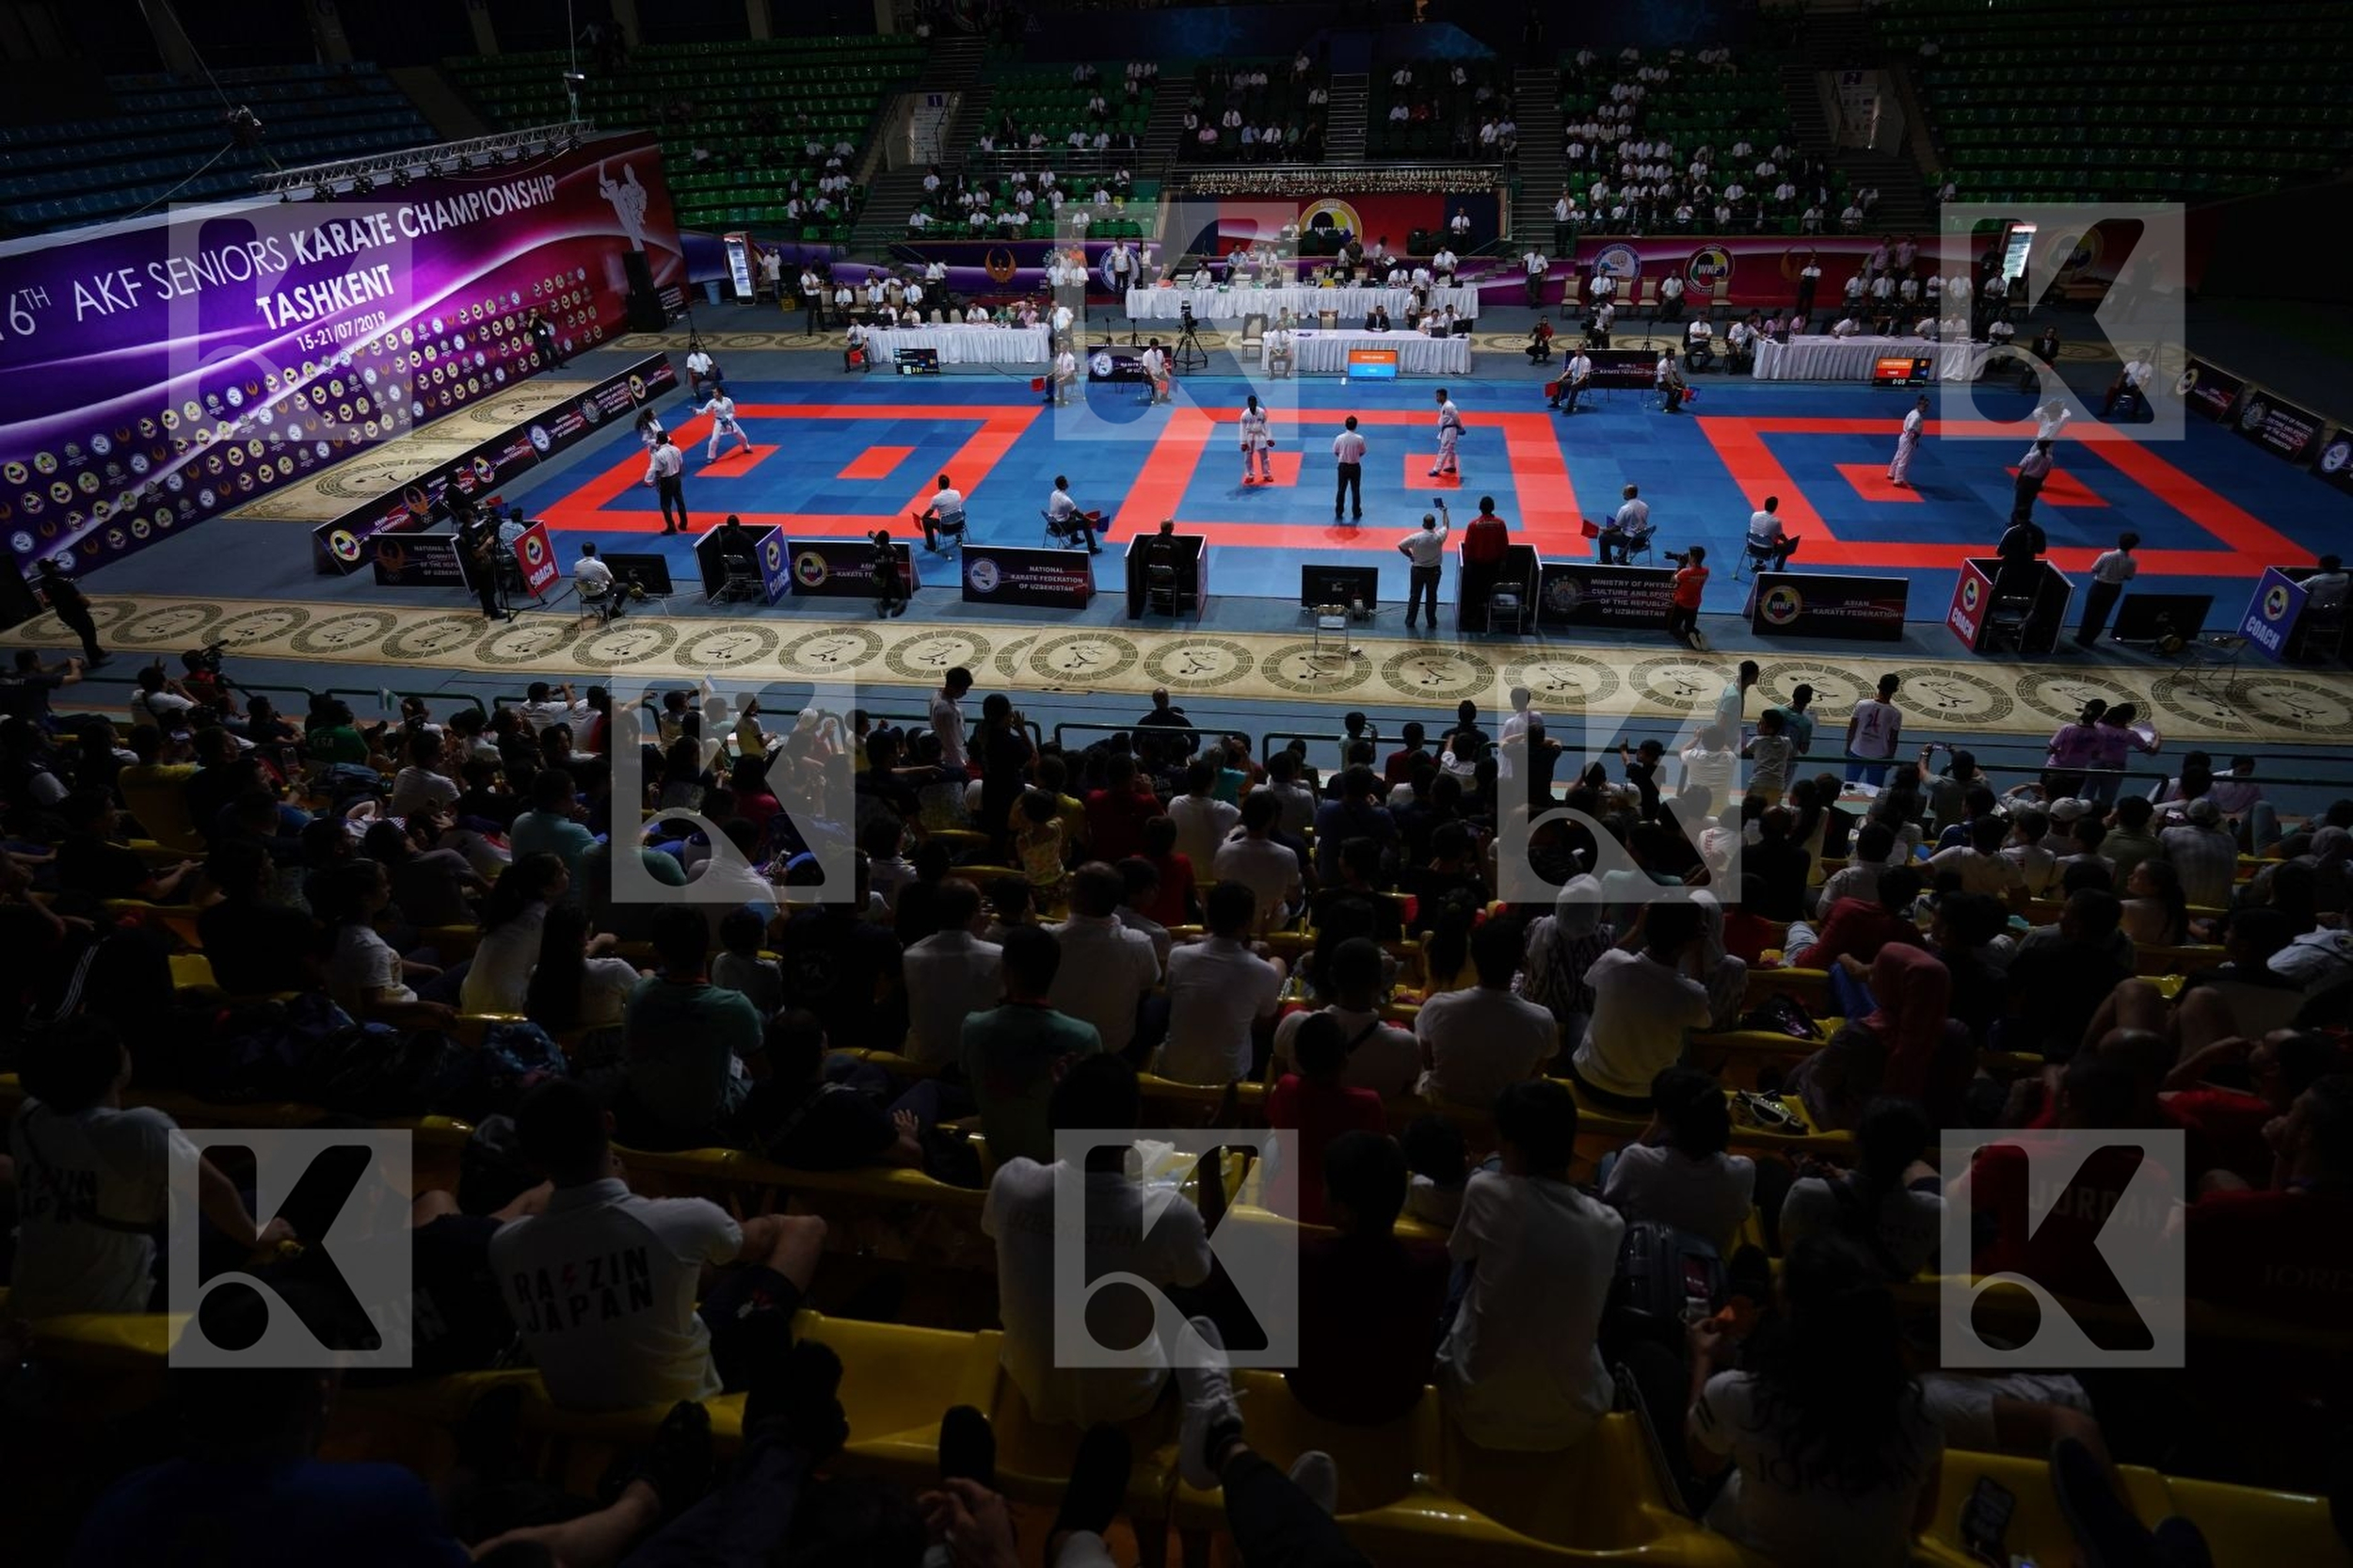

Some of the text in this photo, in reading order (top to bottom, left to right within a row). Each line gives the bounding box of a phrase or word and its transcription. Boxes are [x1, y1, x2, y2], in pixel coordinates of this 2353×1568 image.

[0, 174, 557, 340] 6TH AKF SENIORS KARATE CHAMPIONSHIP
[255, 264, 394, 330] TASHKENT
[296, 311, 387, 352] 15-21/07/2019
[529, 561, 555, 588] COACH
[769, 568, 791, 596] COACH
[1039, 575, 1083, 584] FEDERATION
[1590, 578, 1630, 587] MINISTRY
[1591, 588, 1629, 597] CULTURE
[1812, 607, 1900, 618] KARATE FEDERATION
[1950, 606, 1976, 641] COACH
[2245, 615, 2281, 651] COACH
[526, 1278, 653, 1333] JAPAN
